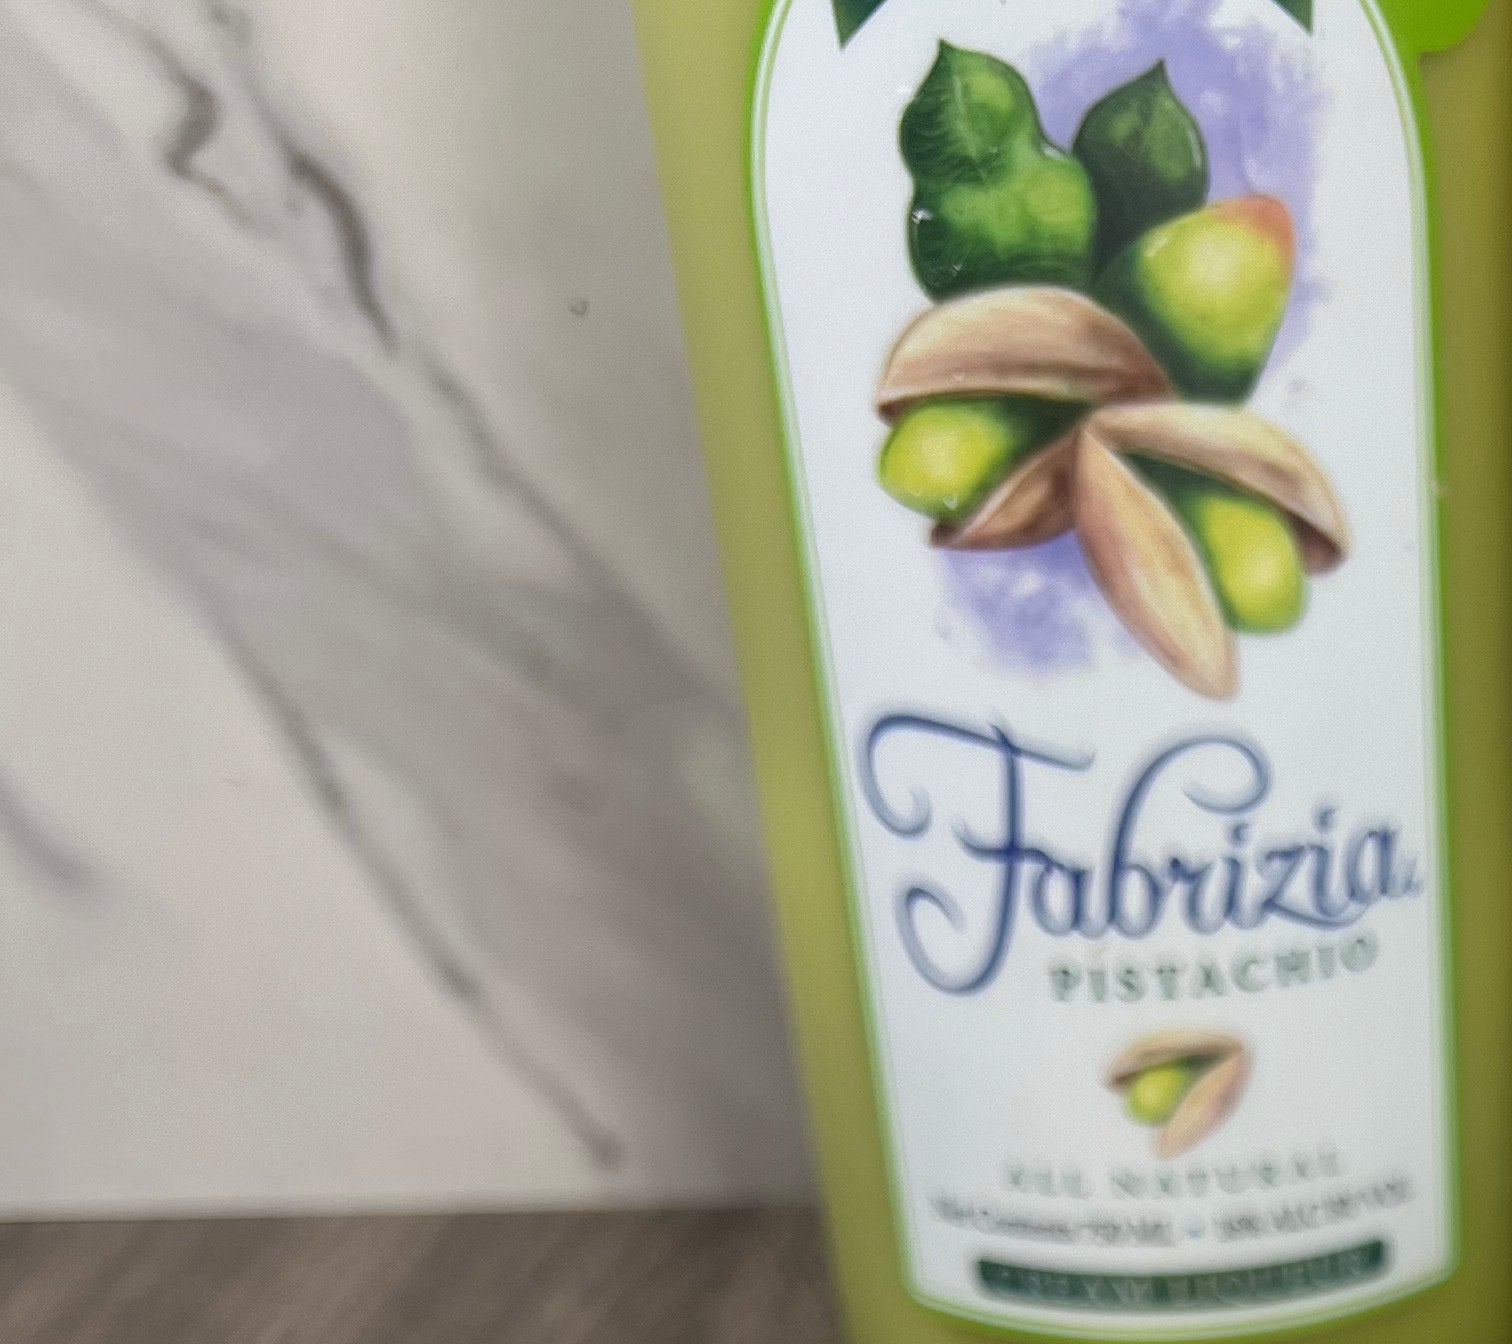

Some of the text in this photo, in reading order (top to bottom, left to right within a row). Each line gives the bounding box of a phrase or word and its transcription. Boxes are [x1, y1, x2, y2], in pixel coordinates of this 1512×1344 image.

[858, 712, 1402, 996] Fabrizia
[1047, 930, 1378, 1003] PISTACHIO
[1108, 1147, 1346, 1200] NATURAL
